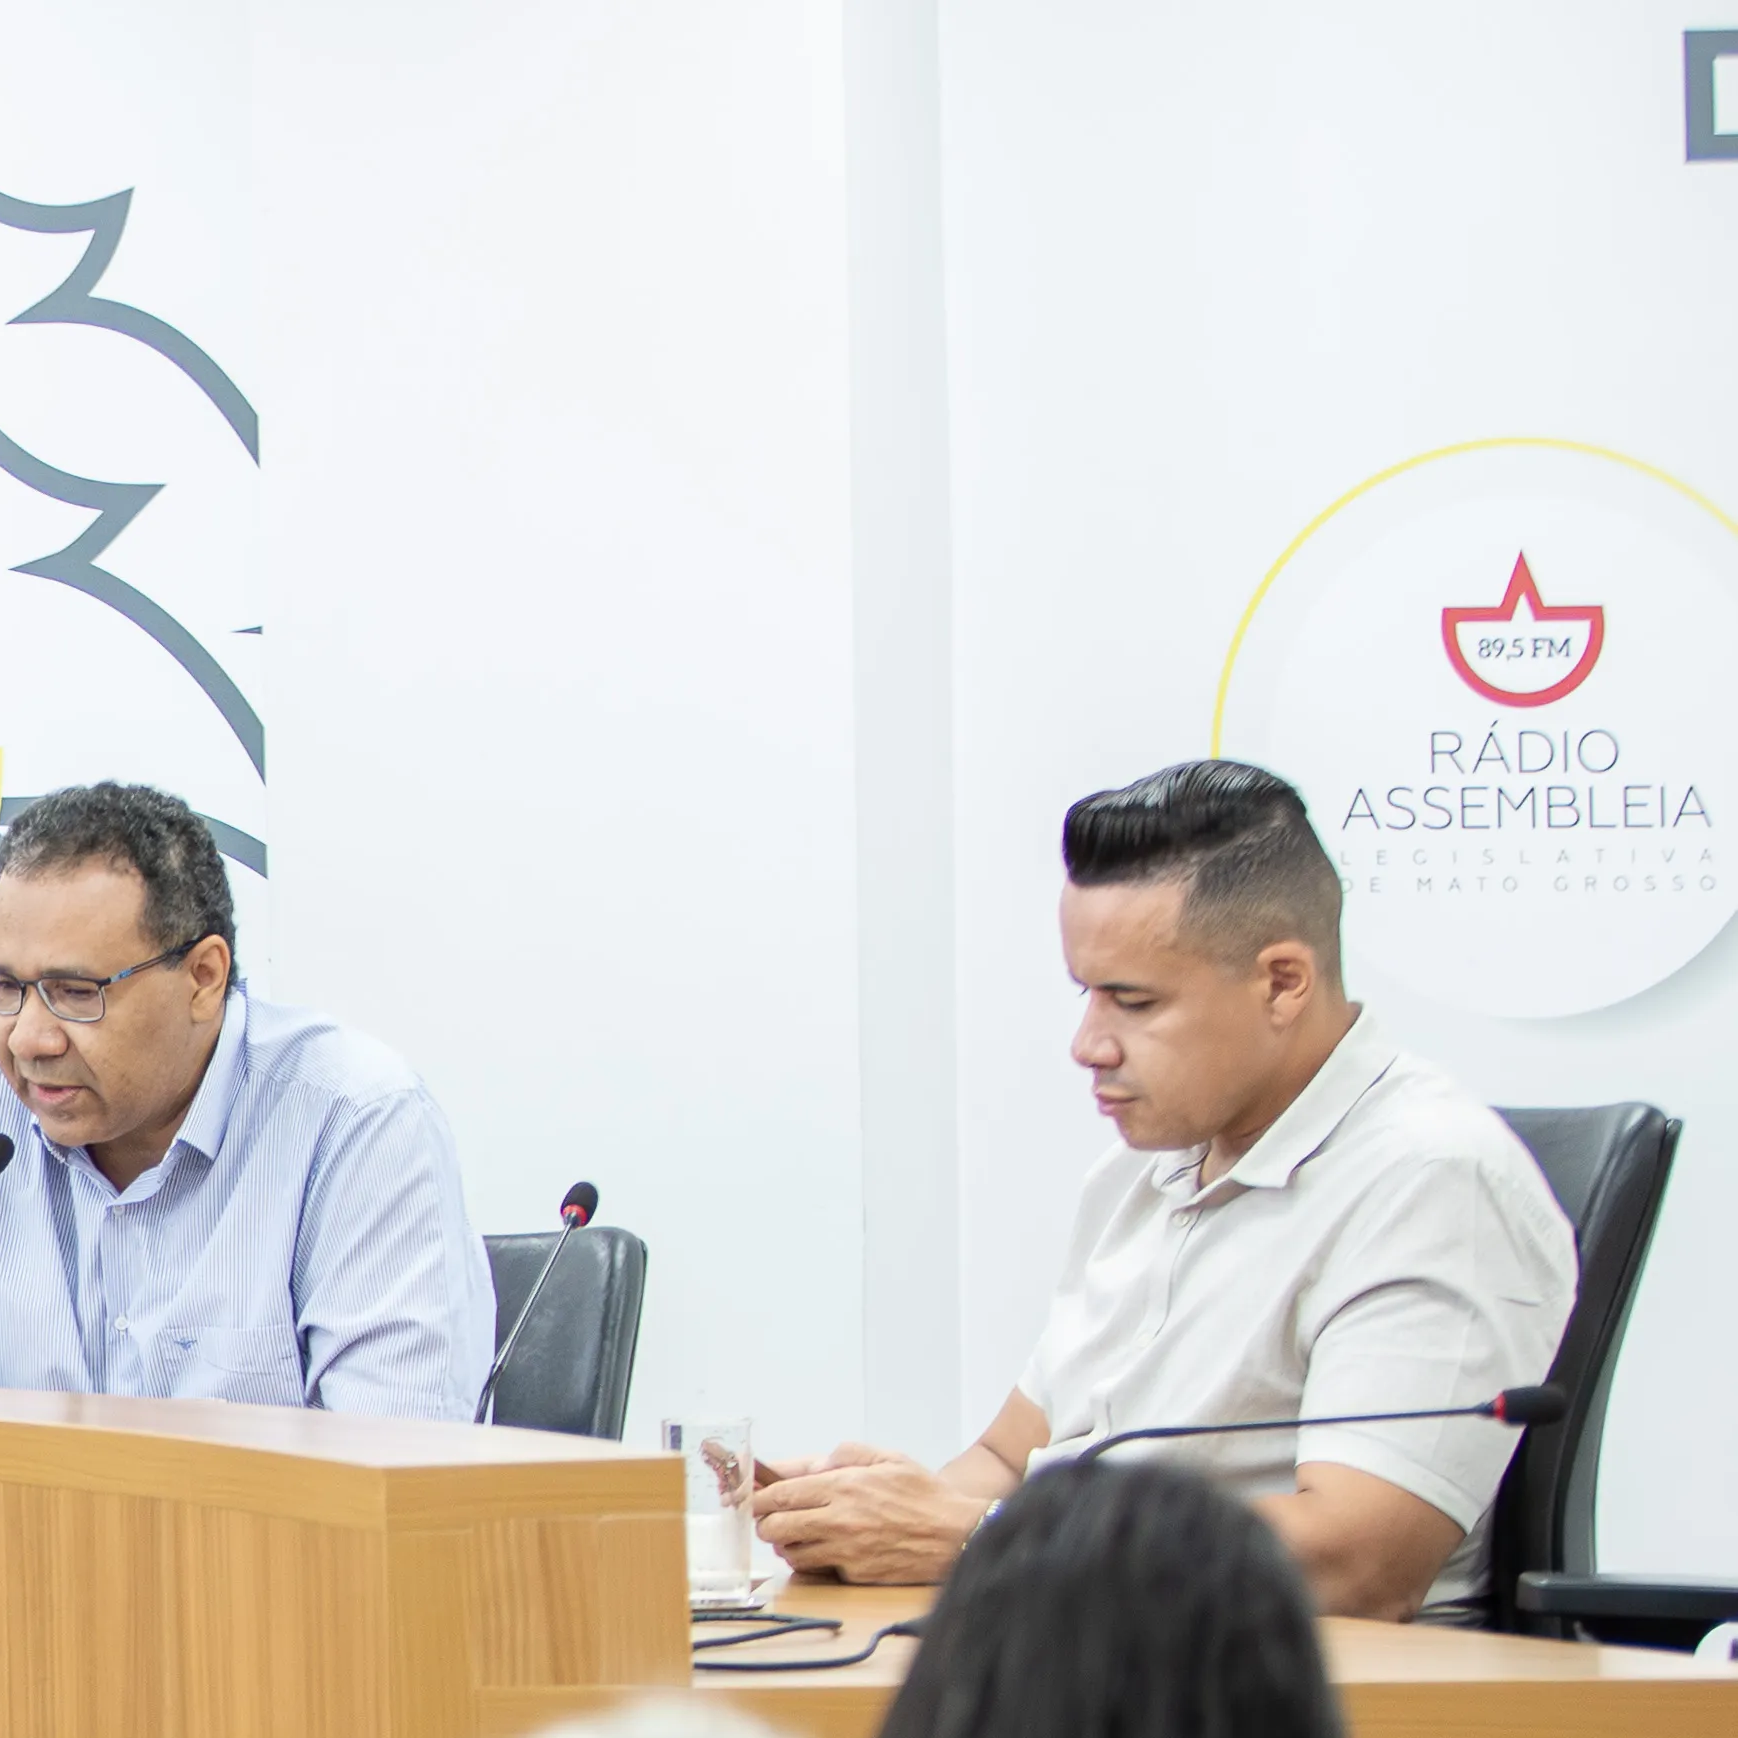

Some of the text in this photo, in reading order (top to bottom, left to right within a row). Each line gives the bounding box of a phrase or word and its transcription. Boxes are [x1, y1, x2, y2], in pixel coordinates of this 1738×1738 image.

[1477, 637, 1571, 662] 89,5 FM
[1429, 719, 1619, 774] RÁDIO
[1342, 785, 1712, 830] ASSEMBLEIA
[1417, 877, 1518, 893] MATO
[1553, 875, 1716, 892] GROSSO
